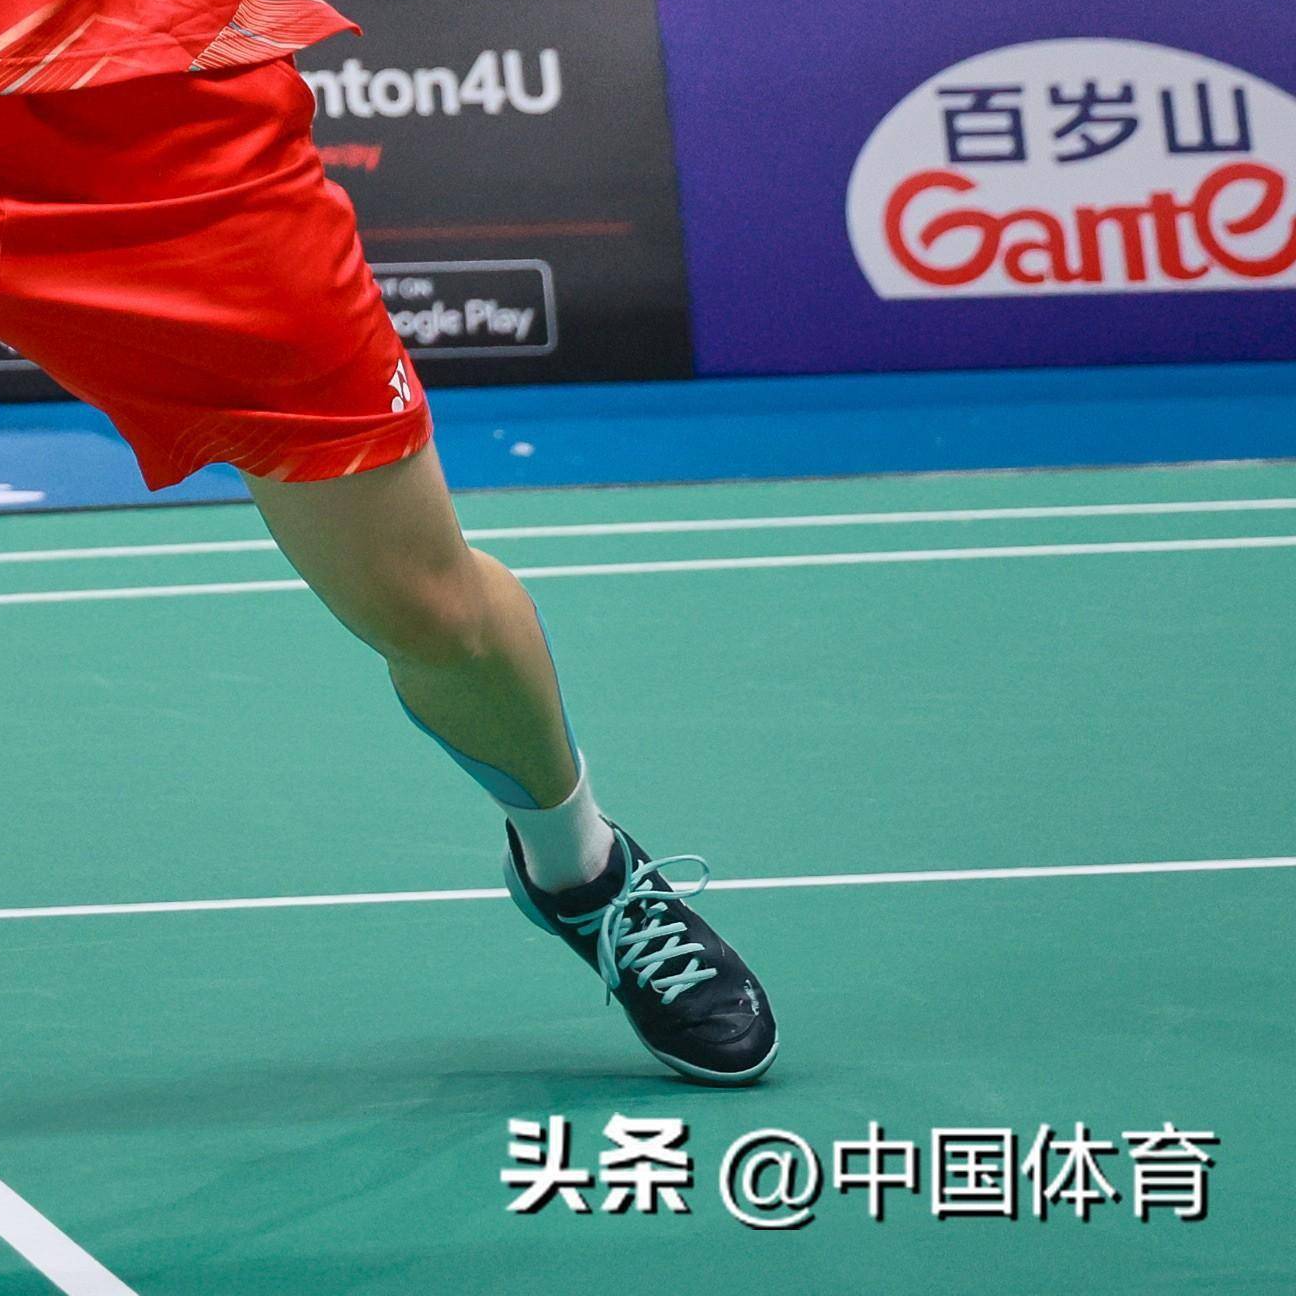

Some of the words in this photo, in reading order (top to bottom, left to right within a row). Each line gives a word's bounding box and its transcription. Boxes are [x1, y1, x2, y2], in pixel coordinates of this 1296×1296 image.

[300, 48, 561, 118] nton4U
[937, 78, 1252, 164] 百岁山
[884, 162, 1296, 286] Gante
[392, 301, 464, 345] ogle
[464, 299, 535, 341] Play
